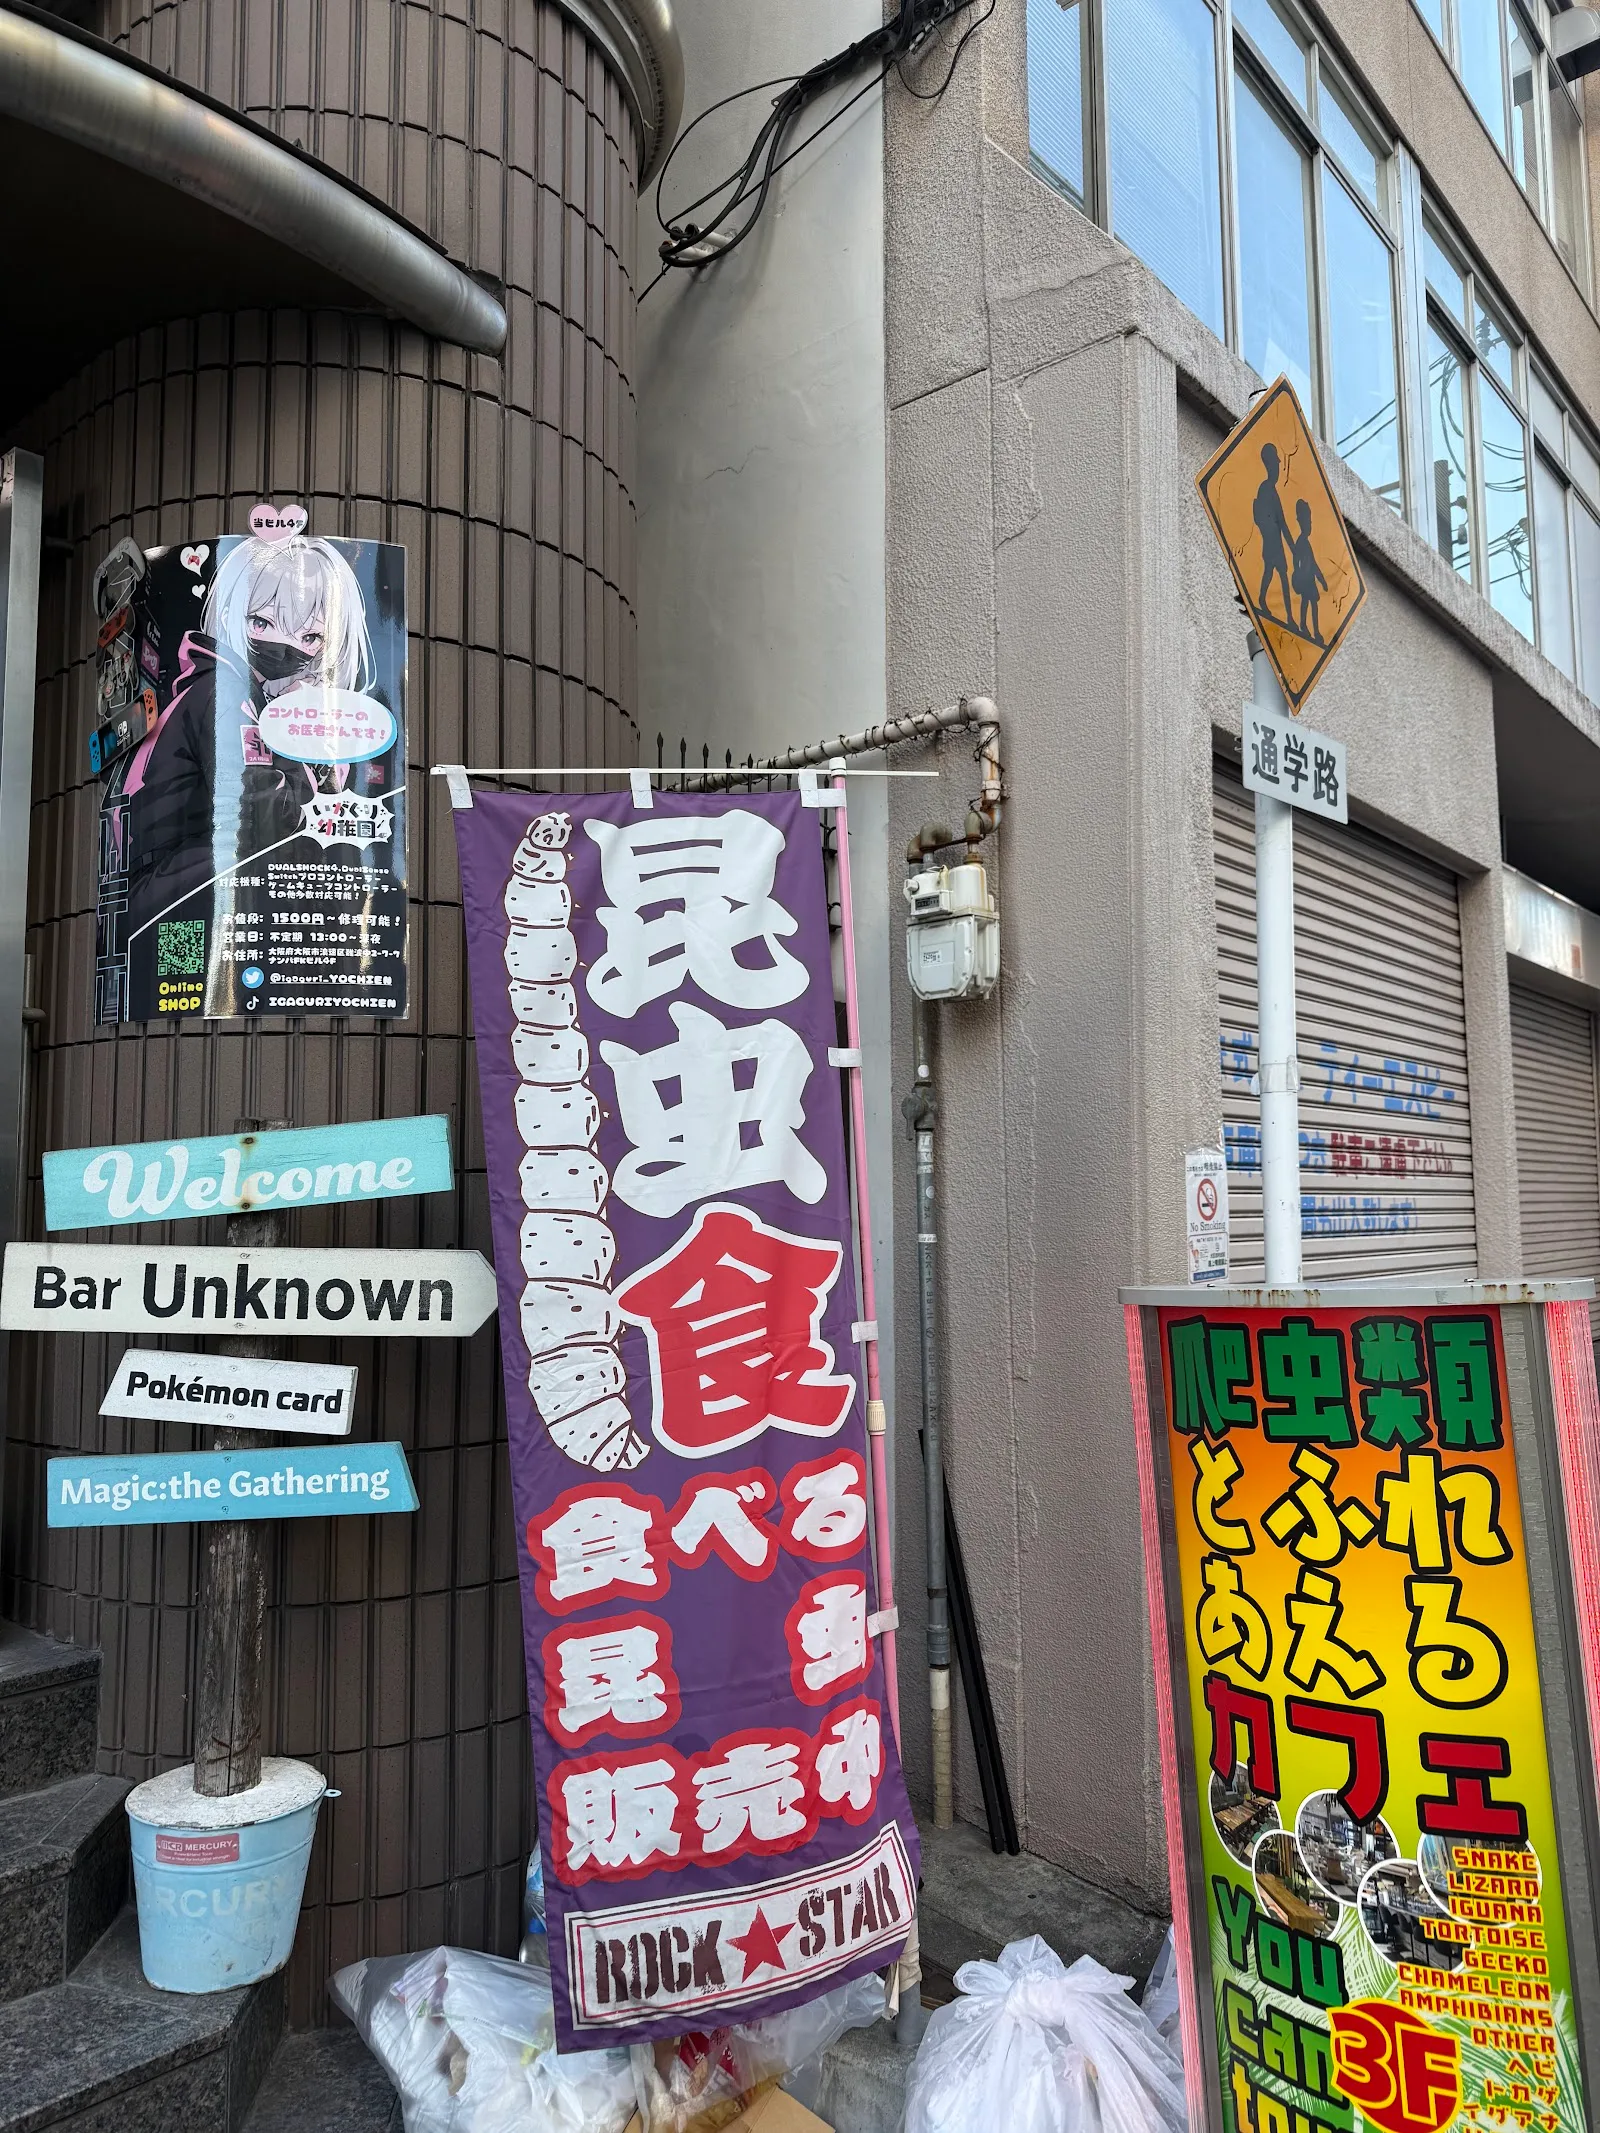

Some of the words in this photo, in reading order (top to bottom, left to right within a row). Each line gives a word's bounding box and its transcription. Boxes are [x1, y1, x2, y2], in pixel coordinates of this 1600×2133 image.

[268, 707, 369, 721] コントローラーの
[1251, 722, 1340, 808] 通学路
[317, 819, 376, 839] 幼稚園
[270, 931, 303, 943] 不定期
[158, 996, 201, 1011] SHOP
[159, 982, 204, 995] Online
[582, 808, 858, 1460] 昆虫食
[83, 1145, 416, 1219] Welcome
[1190, 1222, 1199, 1232] No
[1200, 1220, 1226, 1232] Smoking
[33, 1265, 121, 1310] Bar
[143, 1263, 454, 1323] Unknown
[127, 1370, 268, 1409] Pokémon
[276, 1387, 344, 1414] card
[1168, 1315, 1503, 1450] 爬虫類
[228, 1464, 391, 1501] Gathering
[1193, 1440, 1513, 1573] とふれ
[541, 1461, 867, 1602] 食べる
[1196, 1553, 1508, 1709] あえる
[1203, 1670, 1528, 1843] カフェ
[185, 1840, 233, 1851] MERCURY
[1453, 1848, 1538, 1872] SNAKE
[1449, 1872, 1540, 1898] LIZARD
[1450, 1898, 1543, 1924] IGUANA
[594, 1919, 727, 2004] ROCK
[797, 1860, 902, 1962] STAR
[1421, 1918, 1546, 1950] TORTOISE
[1464, 1950, 1549, 1975] GECKO
[1398, 1964, 1551, 2001] CHAMELEON
[1399, 1989, 1554, 2028] AMPHIBIANS
[1471, 2026, 1556, 2054] OTHER
[1327, 2006, 1462, 2126] 3F
[1507, 2057, 1556, 2080] ヘビ
[1485, 2079, 1558, 2106] トカゲ
[1463, 2104, 1559, 2133] イグアナ
